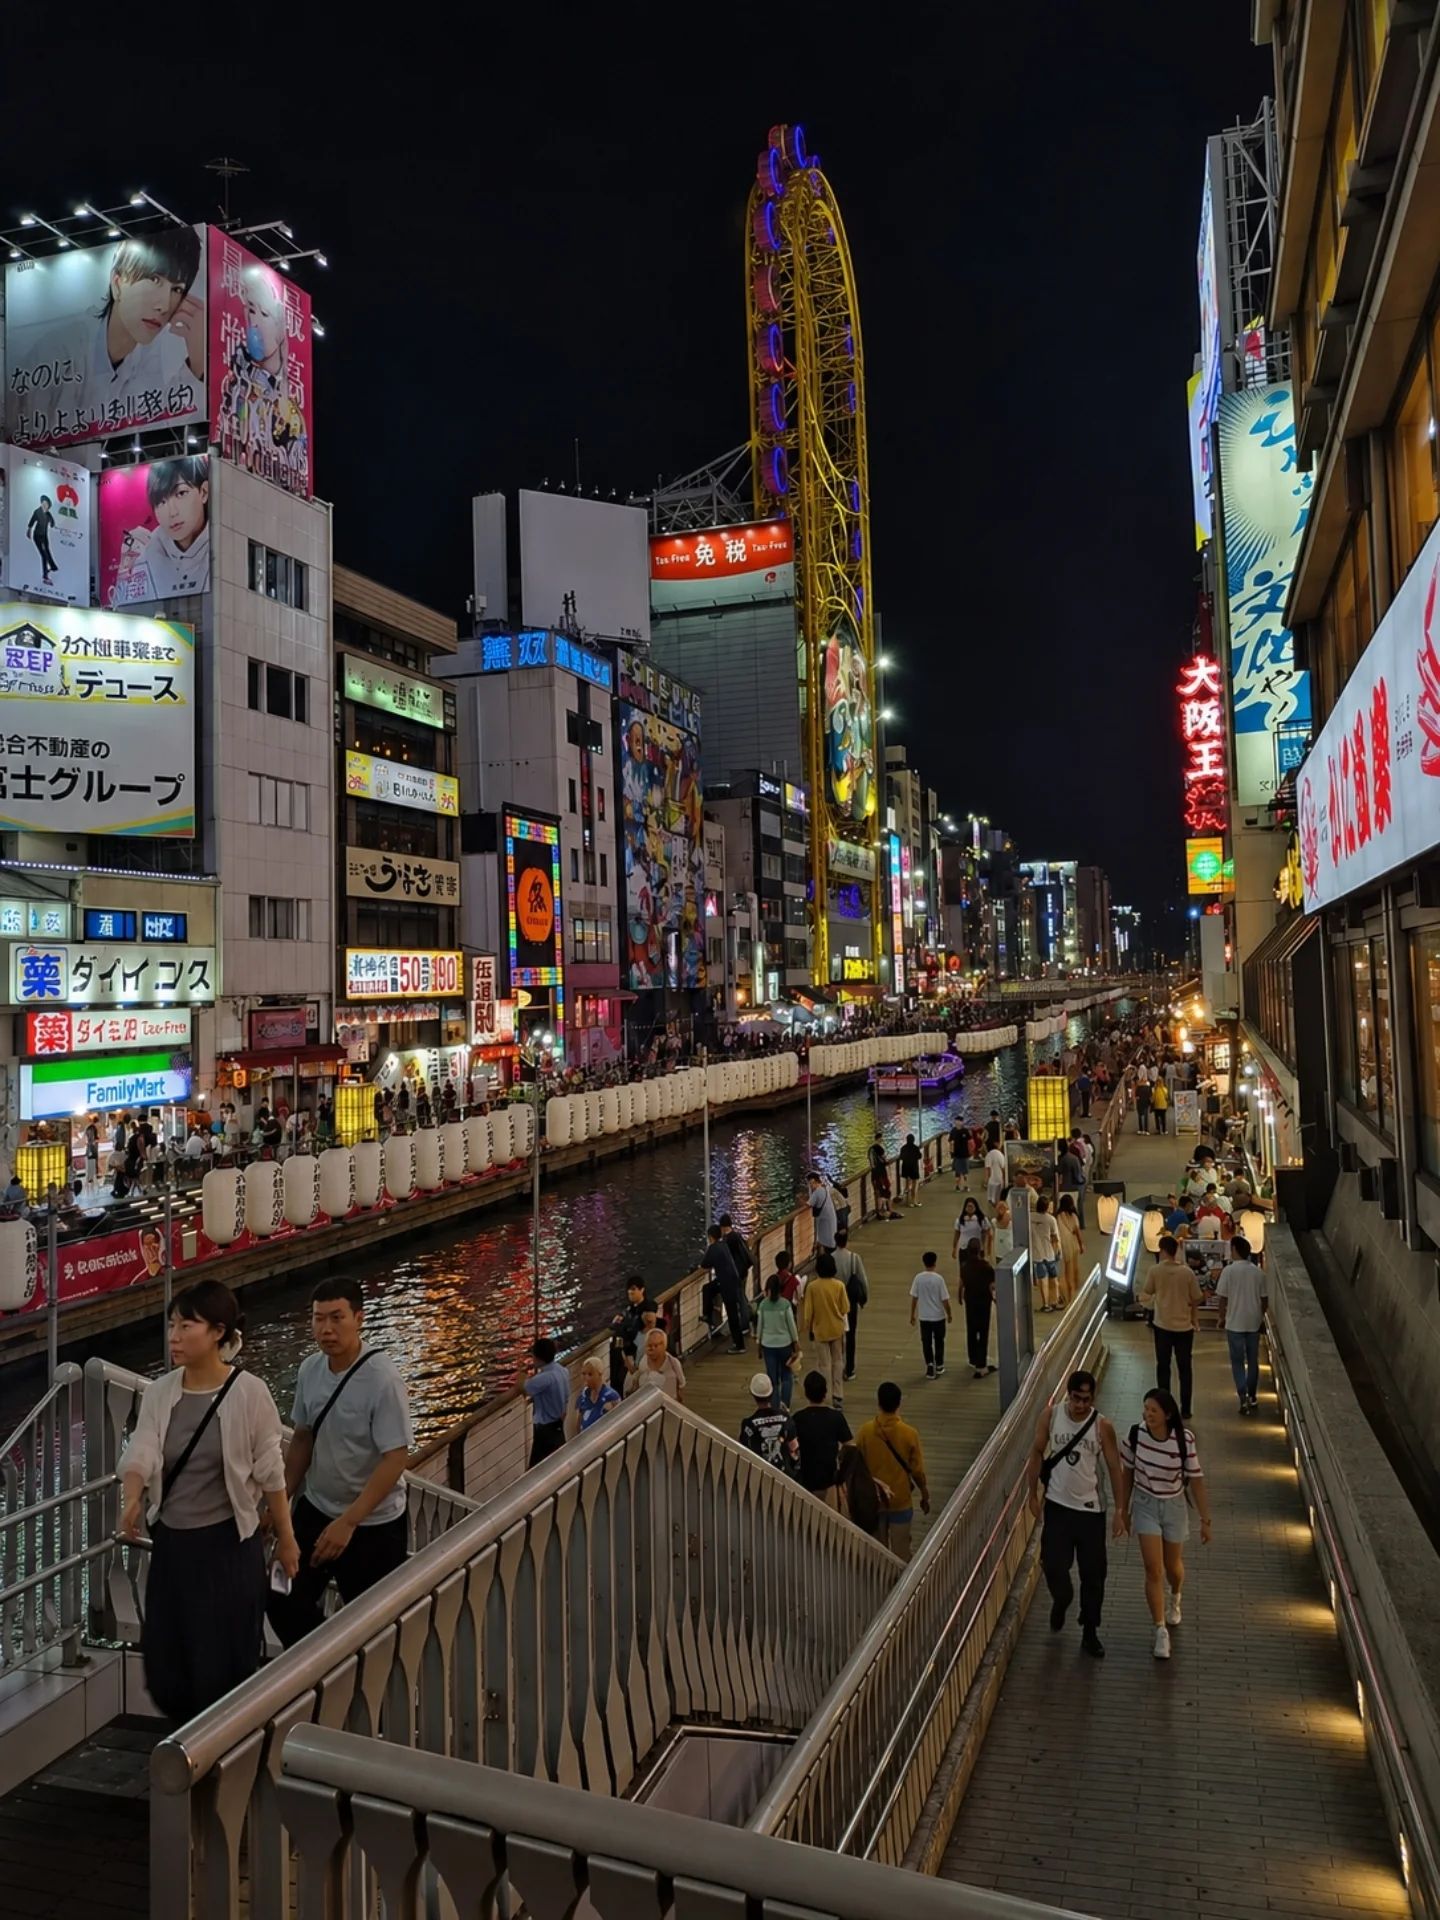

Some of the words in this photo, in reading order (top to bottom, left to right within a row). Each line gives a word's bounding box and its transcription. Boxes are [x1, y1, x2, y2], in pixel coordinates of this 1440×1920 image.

[695, 538, 747, 568] 免税
[0, 733, 111, 760] 合不動産の
[0, 765, 186, 807] 士グループ
[21, 953, 61, 998] 薬
[400, 956, 421, 993] 50
[87, 1077, 166, 1104] FamilyMart
